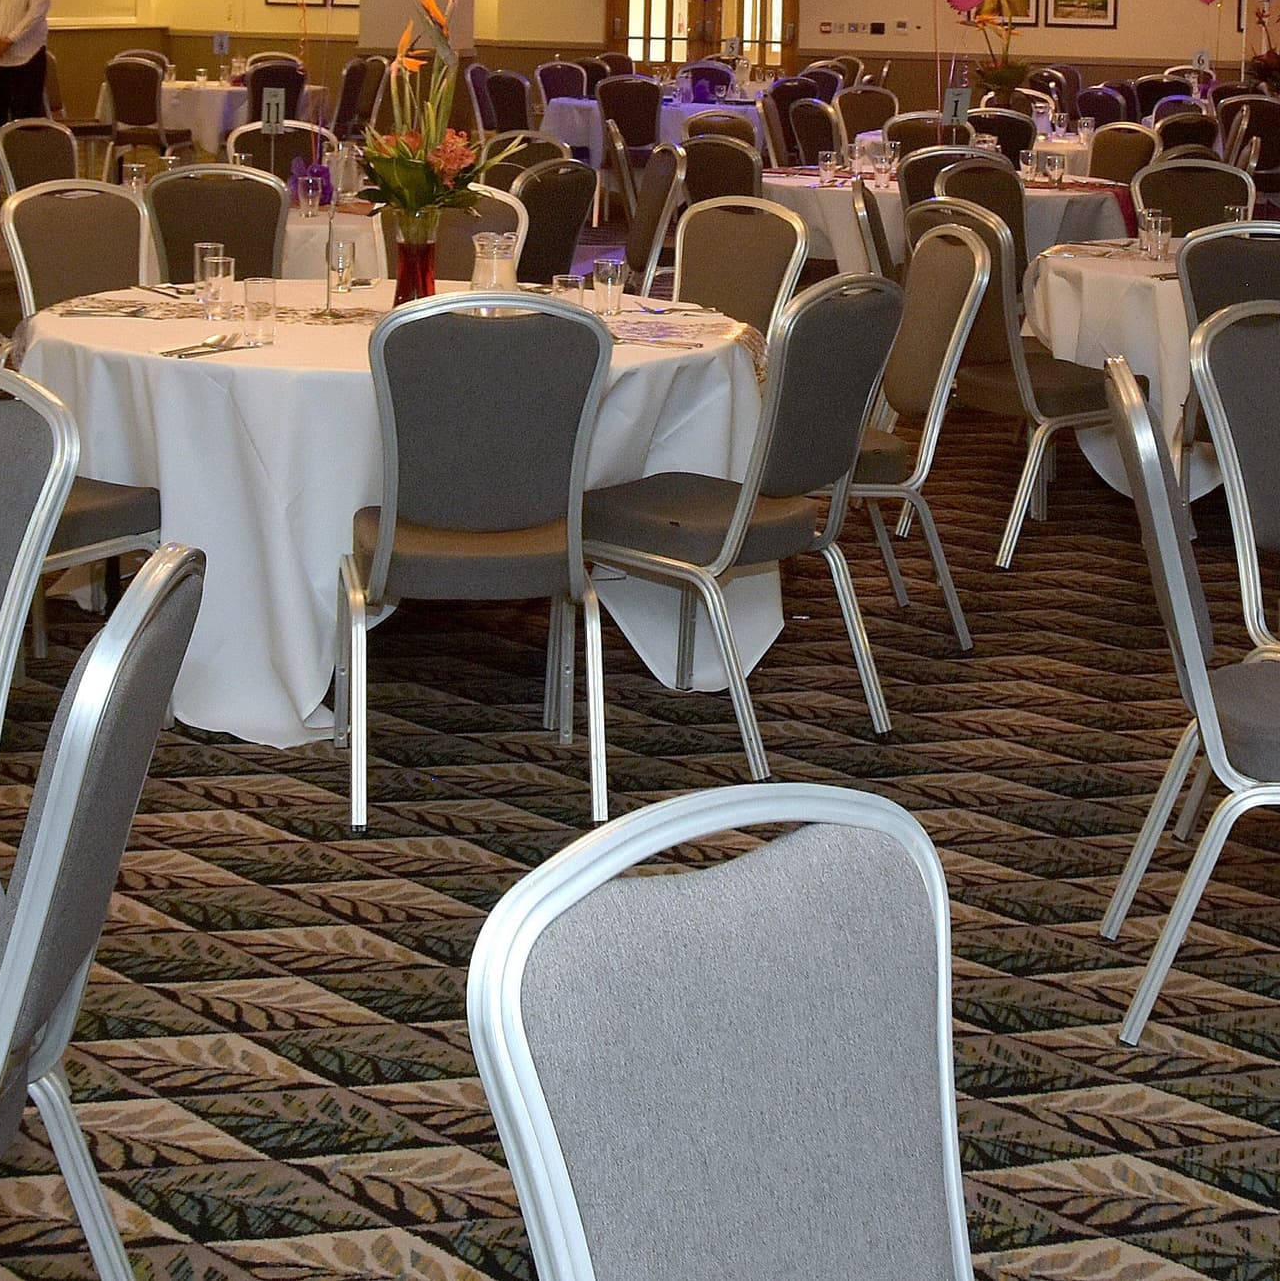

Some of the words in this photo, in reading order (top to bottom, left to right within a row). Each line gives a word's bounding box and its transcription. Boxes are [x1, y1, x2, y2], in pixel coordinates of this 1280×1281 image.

[729, 41, 736, 55] 5
[1197, 54, 1205, 66] 6
[265, 102, 281, 124] 11
[951, 99, 960, 118] 1
